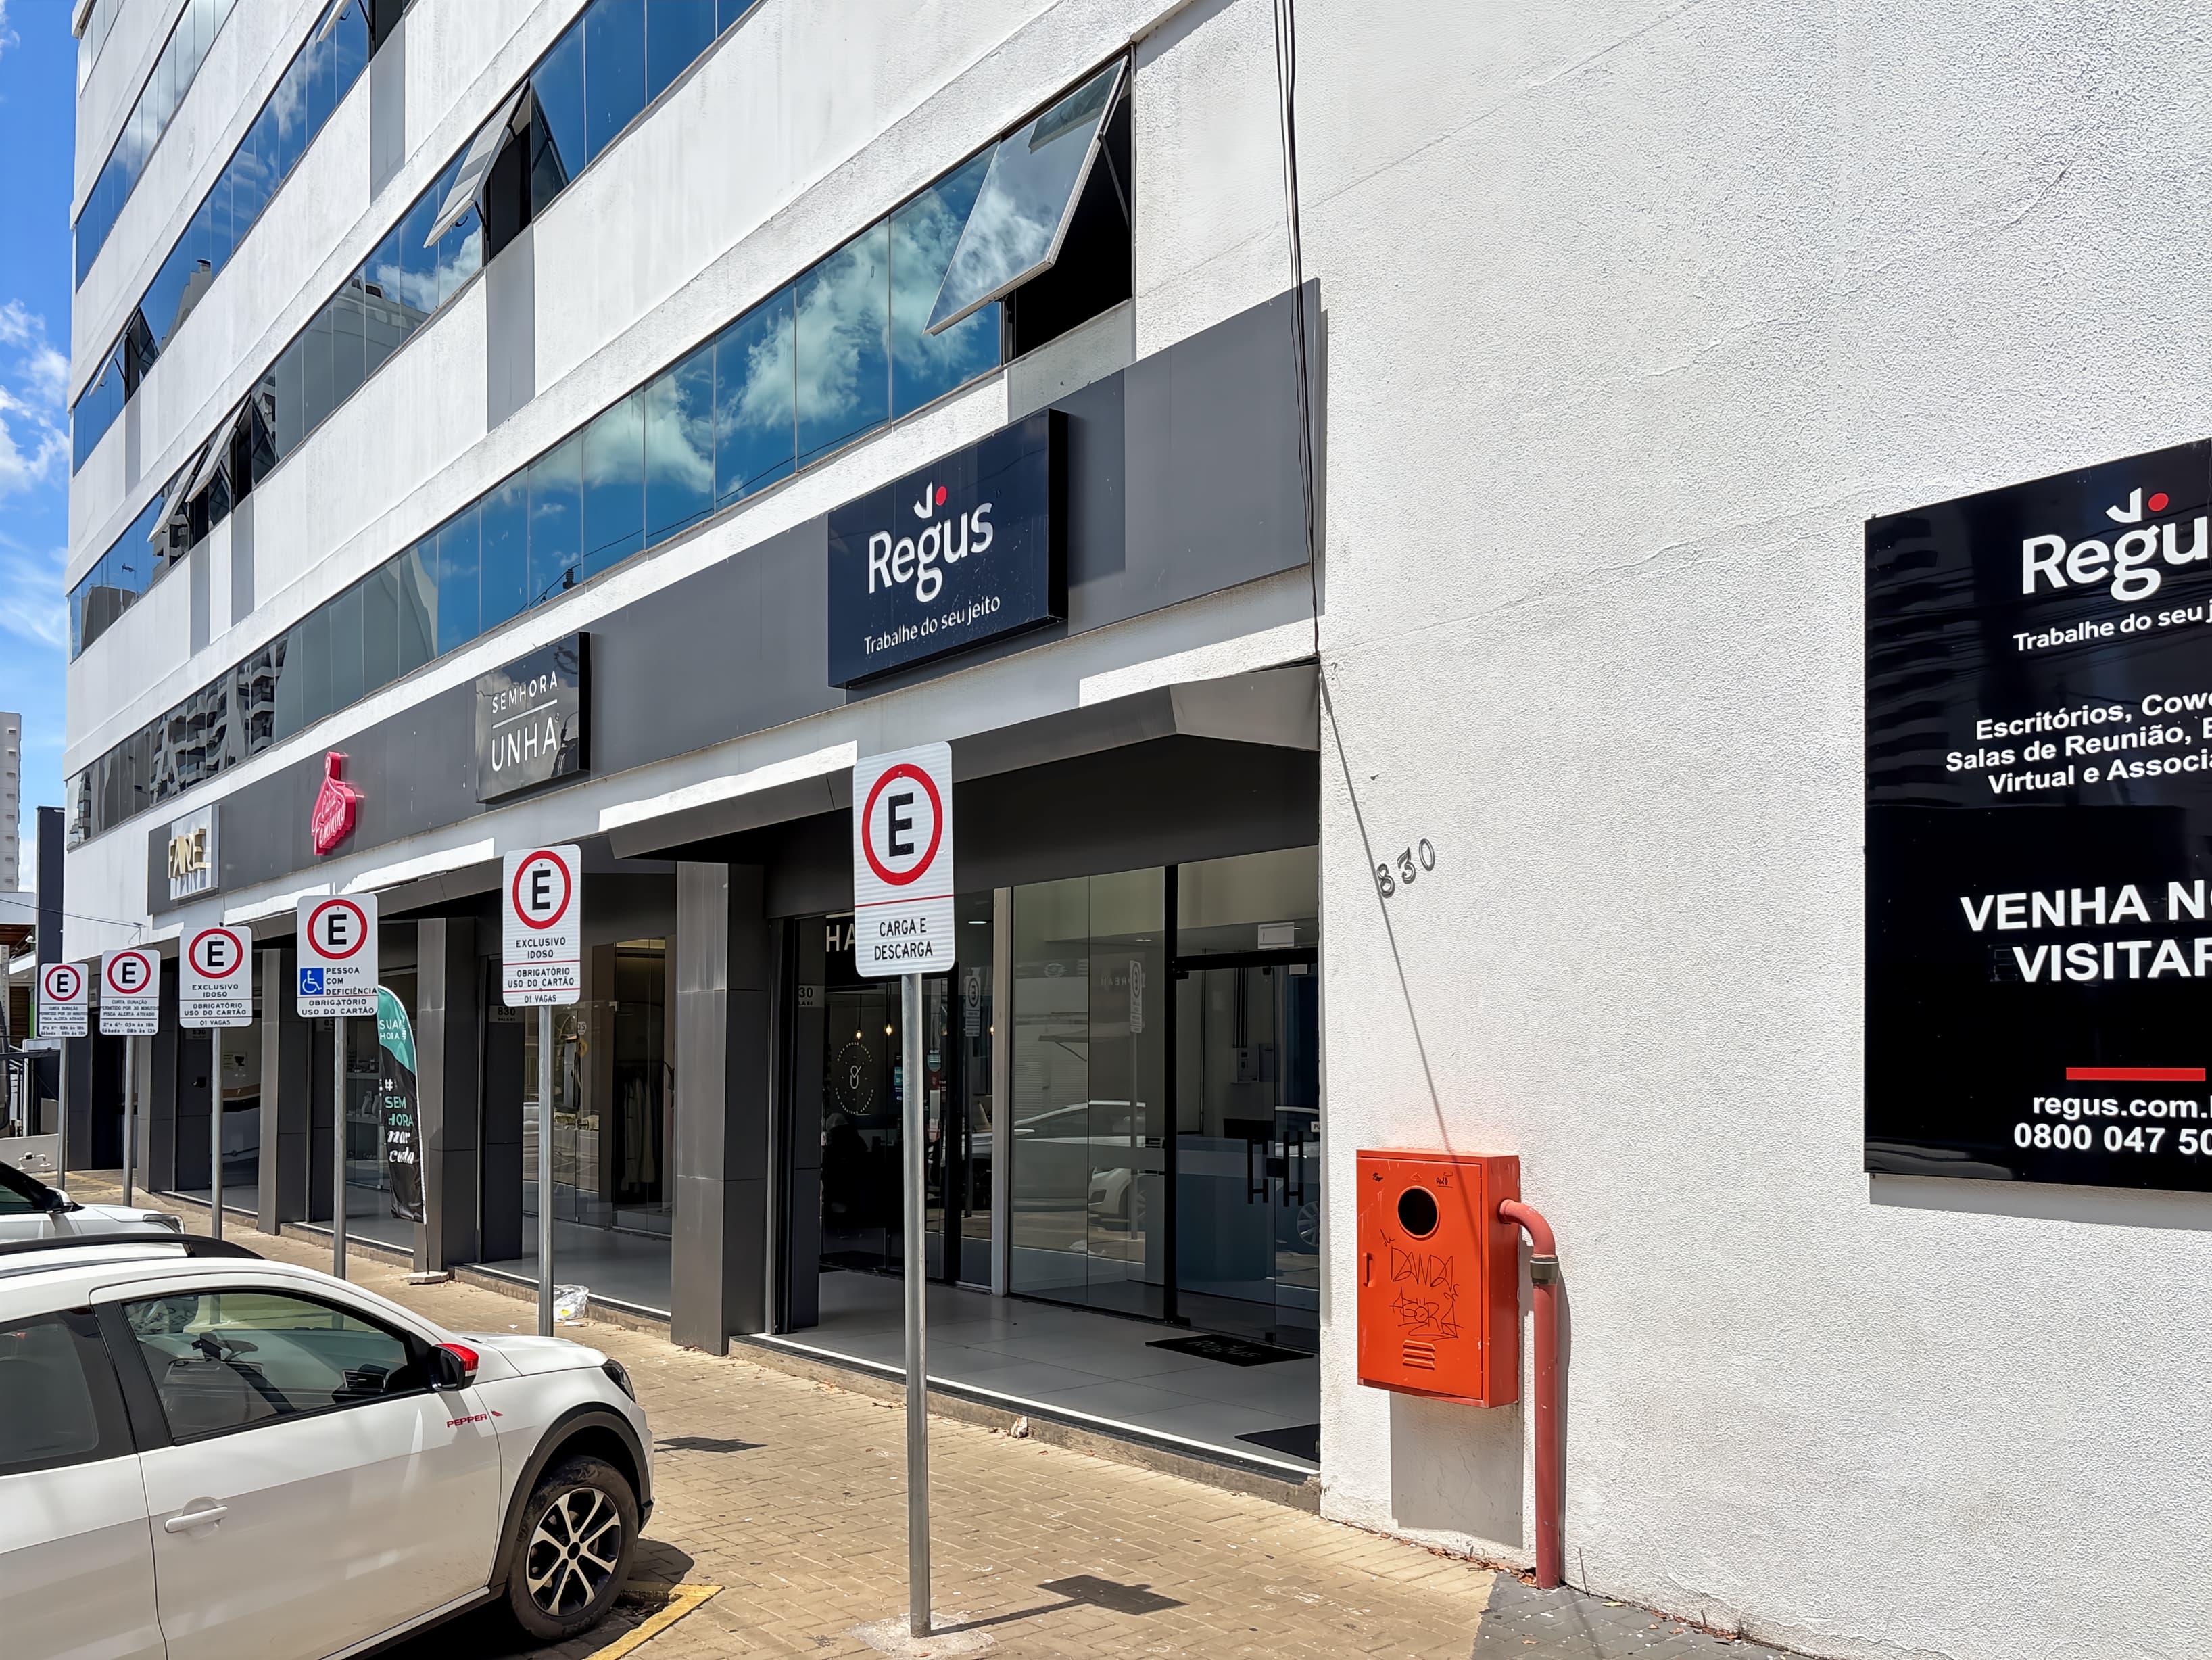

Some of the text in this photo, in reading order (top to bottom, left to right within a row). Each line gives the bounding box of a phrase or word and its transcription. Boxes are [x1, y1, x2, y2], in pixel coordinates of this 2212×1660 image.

[868, 502, 994, 603] Regus
[864, 595, 1001, 655] Trabalhe do seu jeito
[2013, 621, 2115, 651] Trabalhe
[2119, 613, 2152, 634] do
[2157, 606, 2203, 627] seu
[1976, 691, 2212, 740] Escritórios, Cow
[491, 716, 558, 772] UNHA
[1946, 747, 2016, 772] Salas
[2023, 740, 2057, 762] de
[2065, 724, 2192, 757] Reunião,
[1988, 748, 2212, 795] Virtual e Associ
[888, 792, 914, 857] E
[1376, 838, 1435, 898] 830
[531, 869, 551, 911] E
[1960, 879, 2212, 932] VENHA N
[328, 914, 347, 945] E
[880, 918, 927, 937] CARGA E
[516, 936, 566, 948] EXCLUSIVO
[874, 941, 934, 961] DESCARGA
[207, 941, 225, 966] E
[527, 949, 554, 959] IDOSO
[122, 962, 137, 984] E
[517, 966, 570, 977] OBRIGATÓRIO
[527, 979, 538, 987] DO
[542, 976, 575, 987] CARTÃO
[57, 974, 69, 993] E
[326, 987, 377, 995] DEFICIÊNCIA
[193, 1001, 243, 1010] OBRIGATÓRIO
[309, 998, 367, 1006] OBRIGATÓRIO
[534, 995, 556, 1003] VAGAS
[340, 1006, 374, 1014] CARTÃO
[497, 1007, 516, 1016] 830
[379, 1032, 400, 1041] HORA
[385, 1096, 407, 1109] SEM
[2033, 1095, 2212, 1121] regus.com.
[388, 1112, 414, 1127] HORA
[2013, 1122, 2093, 1151] 0800
[2103, 1125, 2166, 1154] 047
[446, 1413, 487, 1428] PEPPER
